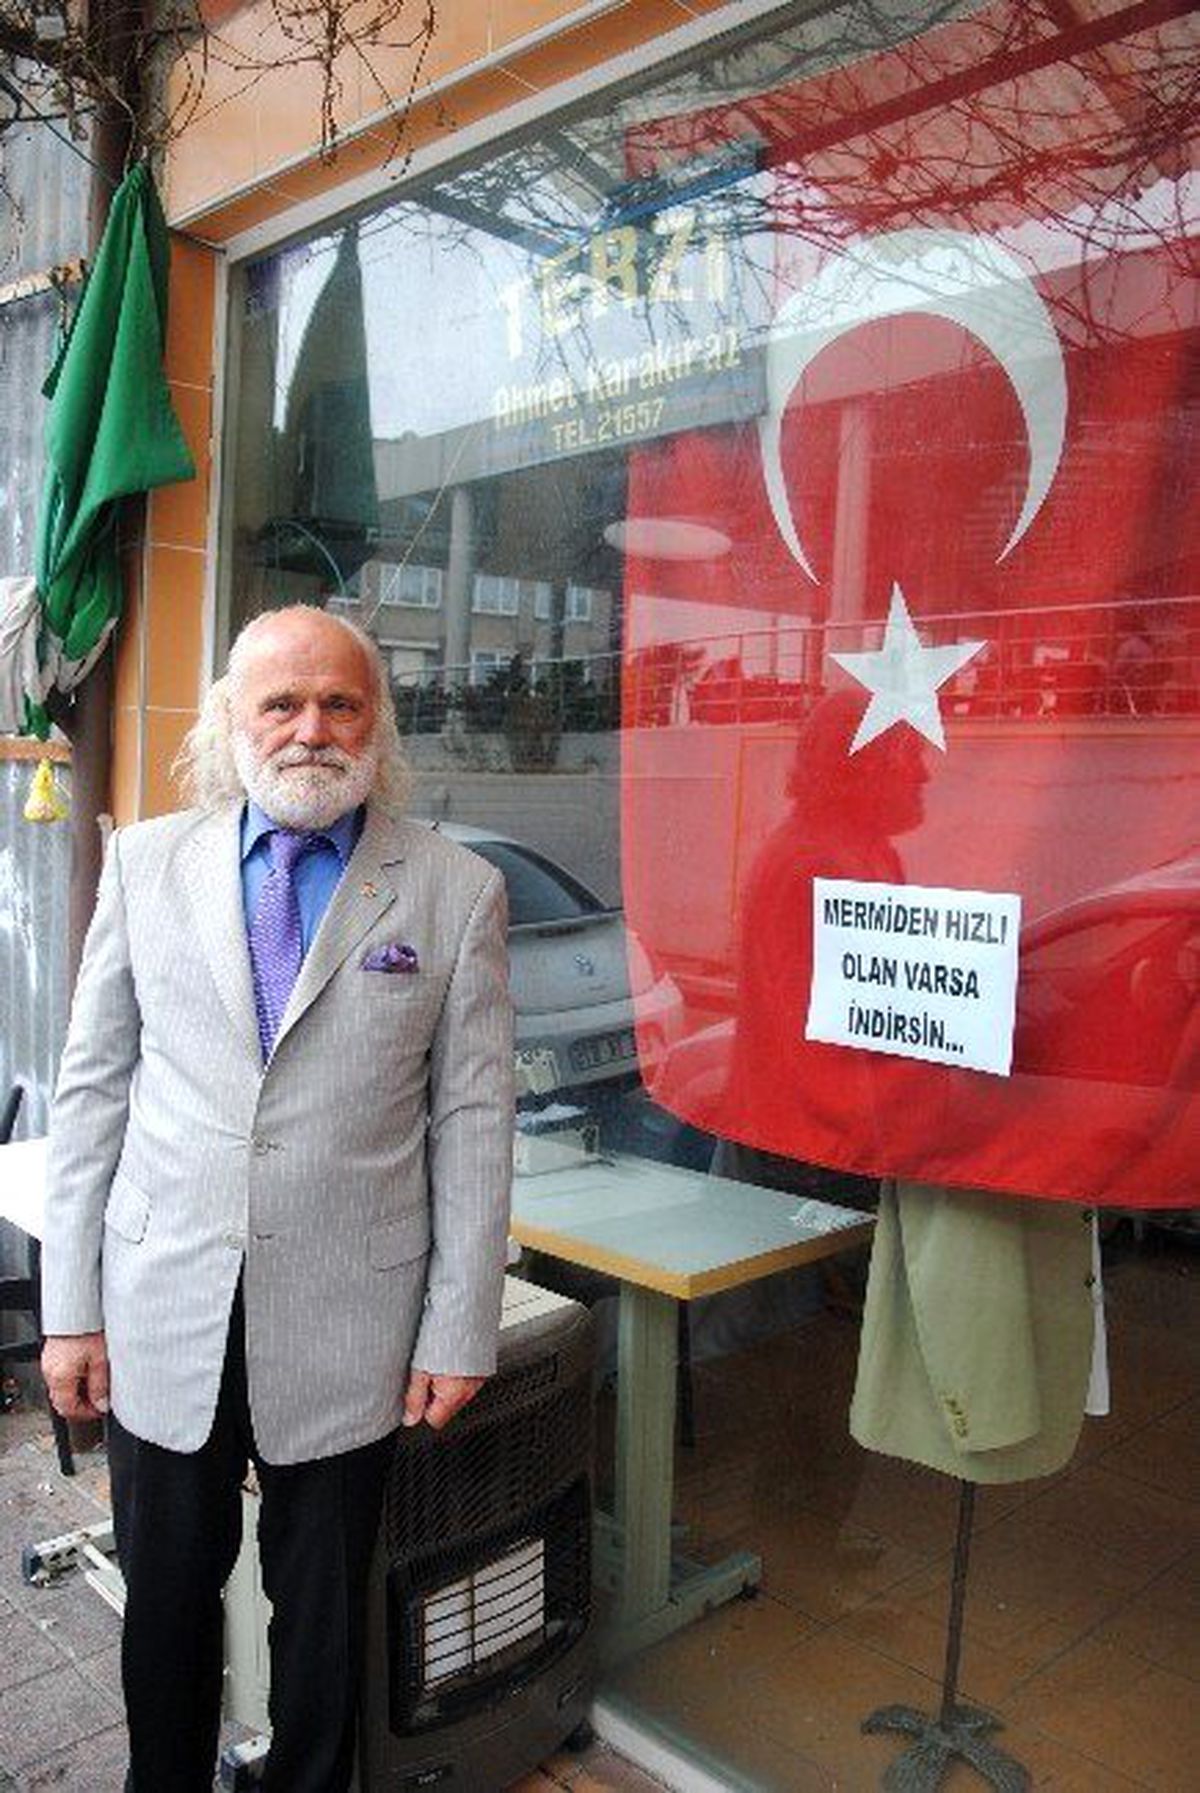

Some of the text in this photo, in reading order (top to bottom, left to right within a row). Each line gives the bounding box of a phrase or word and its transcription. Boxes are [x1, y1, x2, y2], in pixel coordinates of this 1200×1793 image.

[495, 375, 577, 430] Ahmet
[824, 896, 1008, 945] MERMİDEN HIZLI
[842, 952, 981, 1000] OLAN VARSA
[848, 998, 965, 1055] İNDİRSİN...
